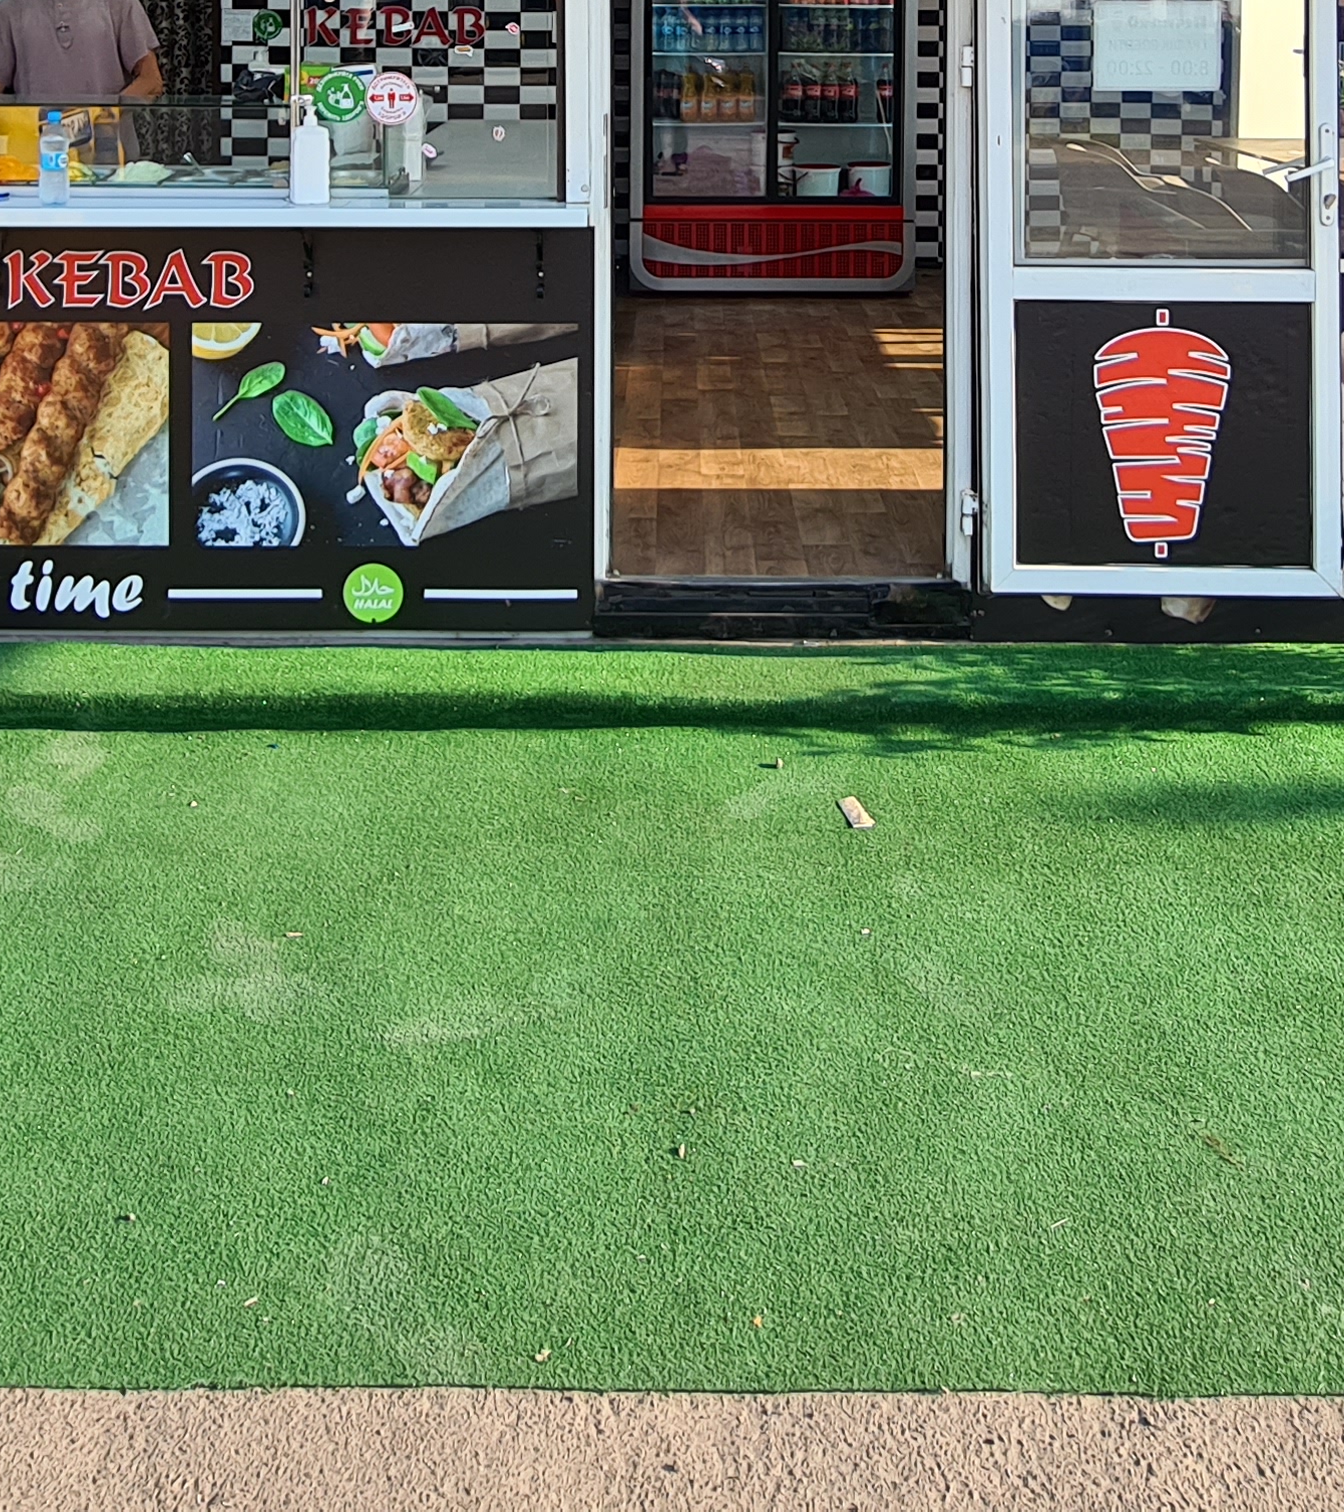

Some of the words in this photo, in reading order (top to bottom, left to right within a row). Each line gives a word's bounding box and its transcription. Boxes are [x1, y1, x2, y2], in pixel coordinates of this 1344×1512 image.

[305, 5, 486, 47] KEBAB
[4, 248, 255, 311] KEBAB
[8, 559, 144, 620] time
[351, 574, 395, 597] حلال
[354, 598, 393, 609] HALAL
